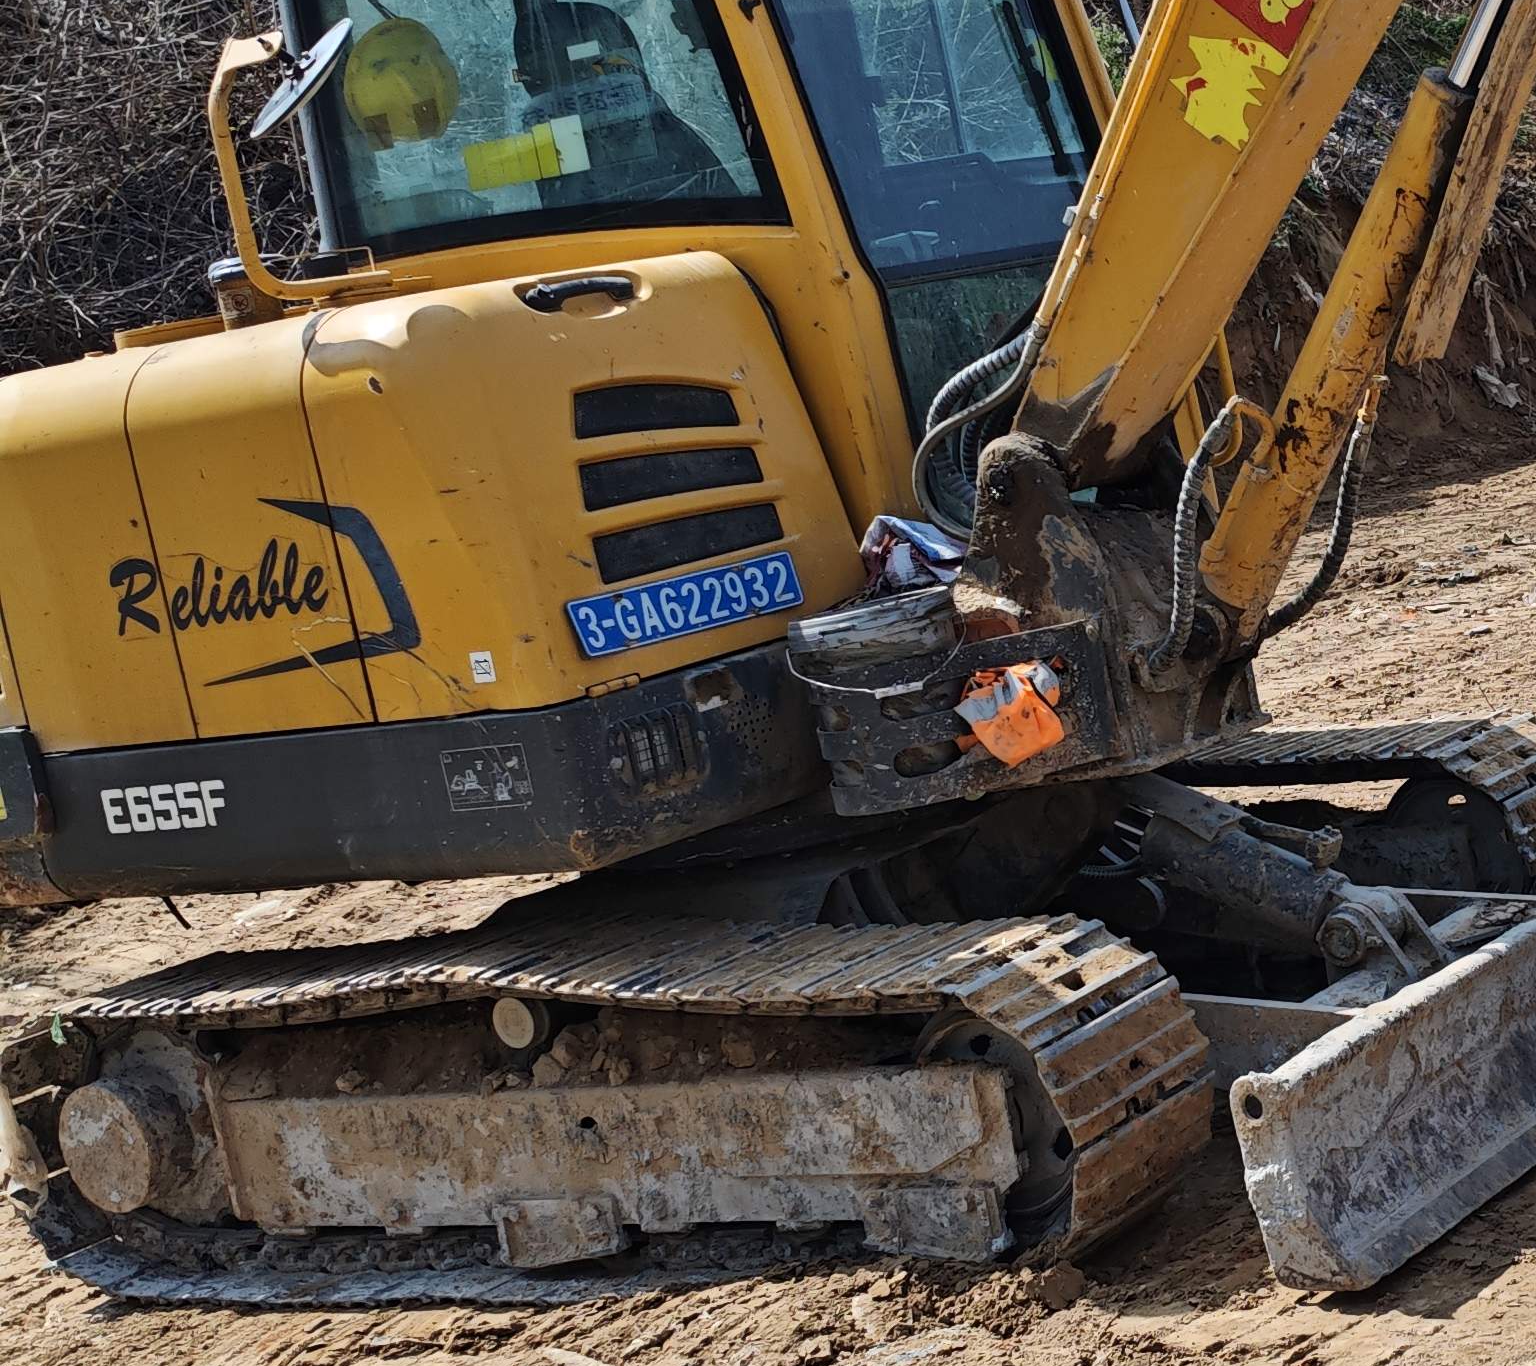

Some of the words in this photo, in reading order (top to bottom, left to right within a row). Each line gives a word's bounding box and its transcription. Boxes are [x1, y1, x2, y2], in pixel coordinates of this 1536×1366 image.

[109, 537, 330, 636] Reliable
[578, 561, 796, 649] 3-GA622932
[100, 779, 227, 835] E655F
